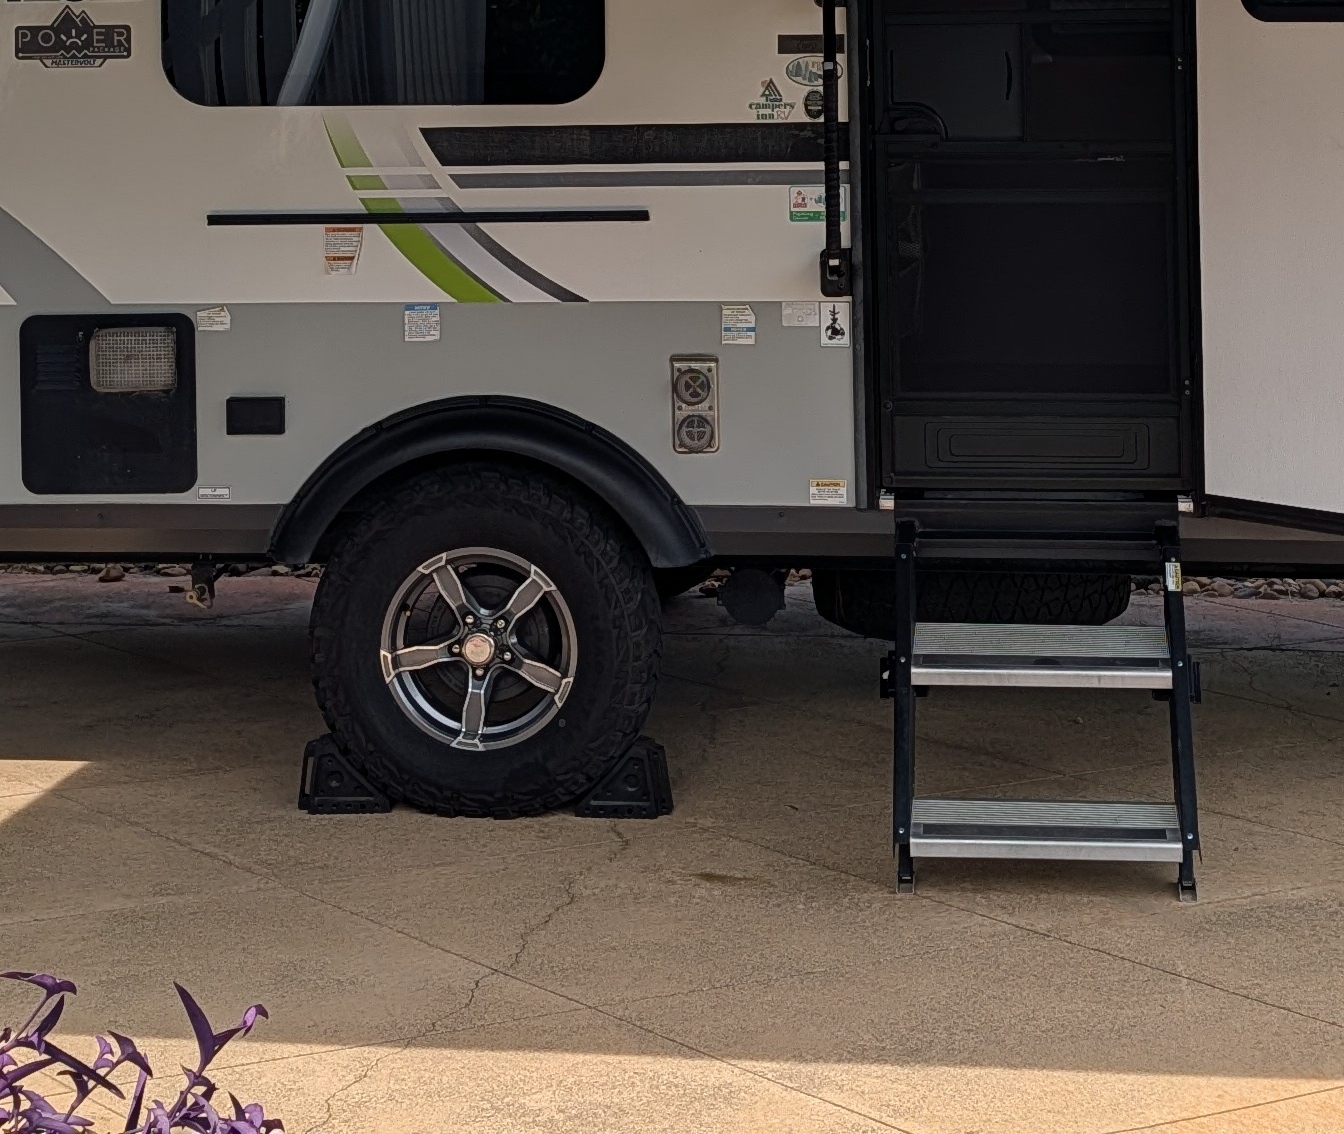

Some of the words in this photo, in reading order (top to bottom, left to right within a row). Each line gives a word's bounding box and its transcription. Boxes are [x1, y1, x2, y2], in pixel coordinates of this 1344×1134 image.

[748, 102, 796, 112] campers
[757, 111, 775, 120] inn
[776, 109, 794, 120] RV
